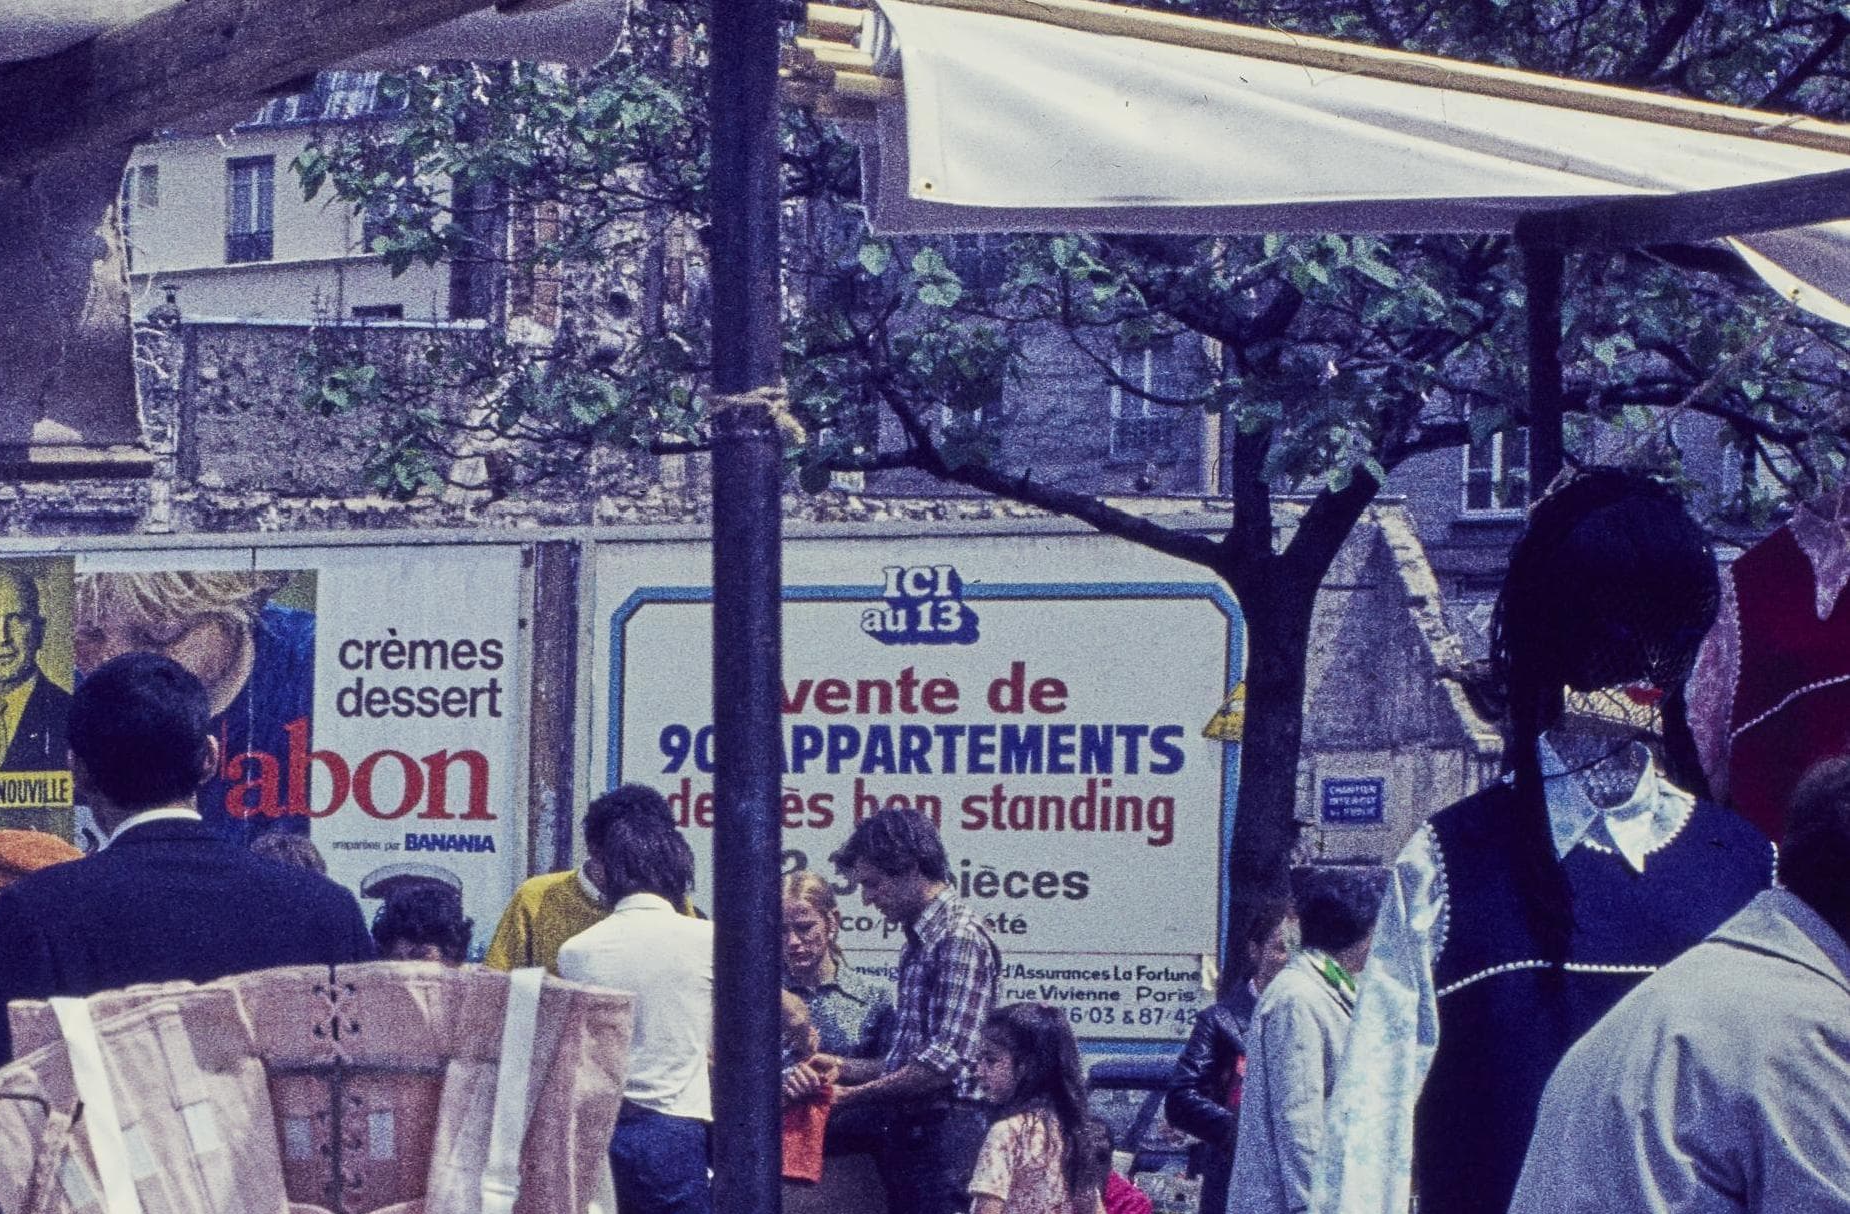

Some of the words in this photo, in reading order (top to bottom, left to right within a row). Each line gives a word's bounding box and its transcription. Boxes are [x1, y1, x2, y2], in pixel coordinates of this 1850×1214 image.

[881, 564, 954, 598] ICI
[861, 605, 907, 633] au
[916, 600, 964, 633] 13
[338, 628, 504, 670] crèmes
[336, 677, 503, 718] dessert
[781, 666, 959, 714] vente
[987, 661, 1068, 714] de
[782, 723, 1186, 775] PPARTEMENTS
[781, 786, 834, 829] ès
[961, 777, 1176, 848] standing
[404, 832, 497, 854] BANANIA
[949, 858, 1090, 901] ièces
[1006, 988, 1037, 1001] rue
[1039, 984, 1121, 1001] Vivienne
[1136, 985, 1197, 1003] Paris
[1113, 964, 1133, 981] La
[1135, 965, 1201, 982] Fortune
